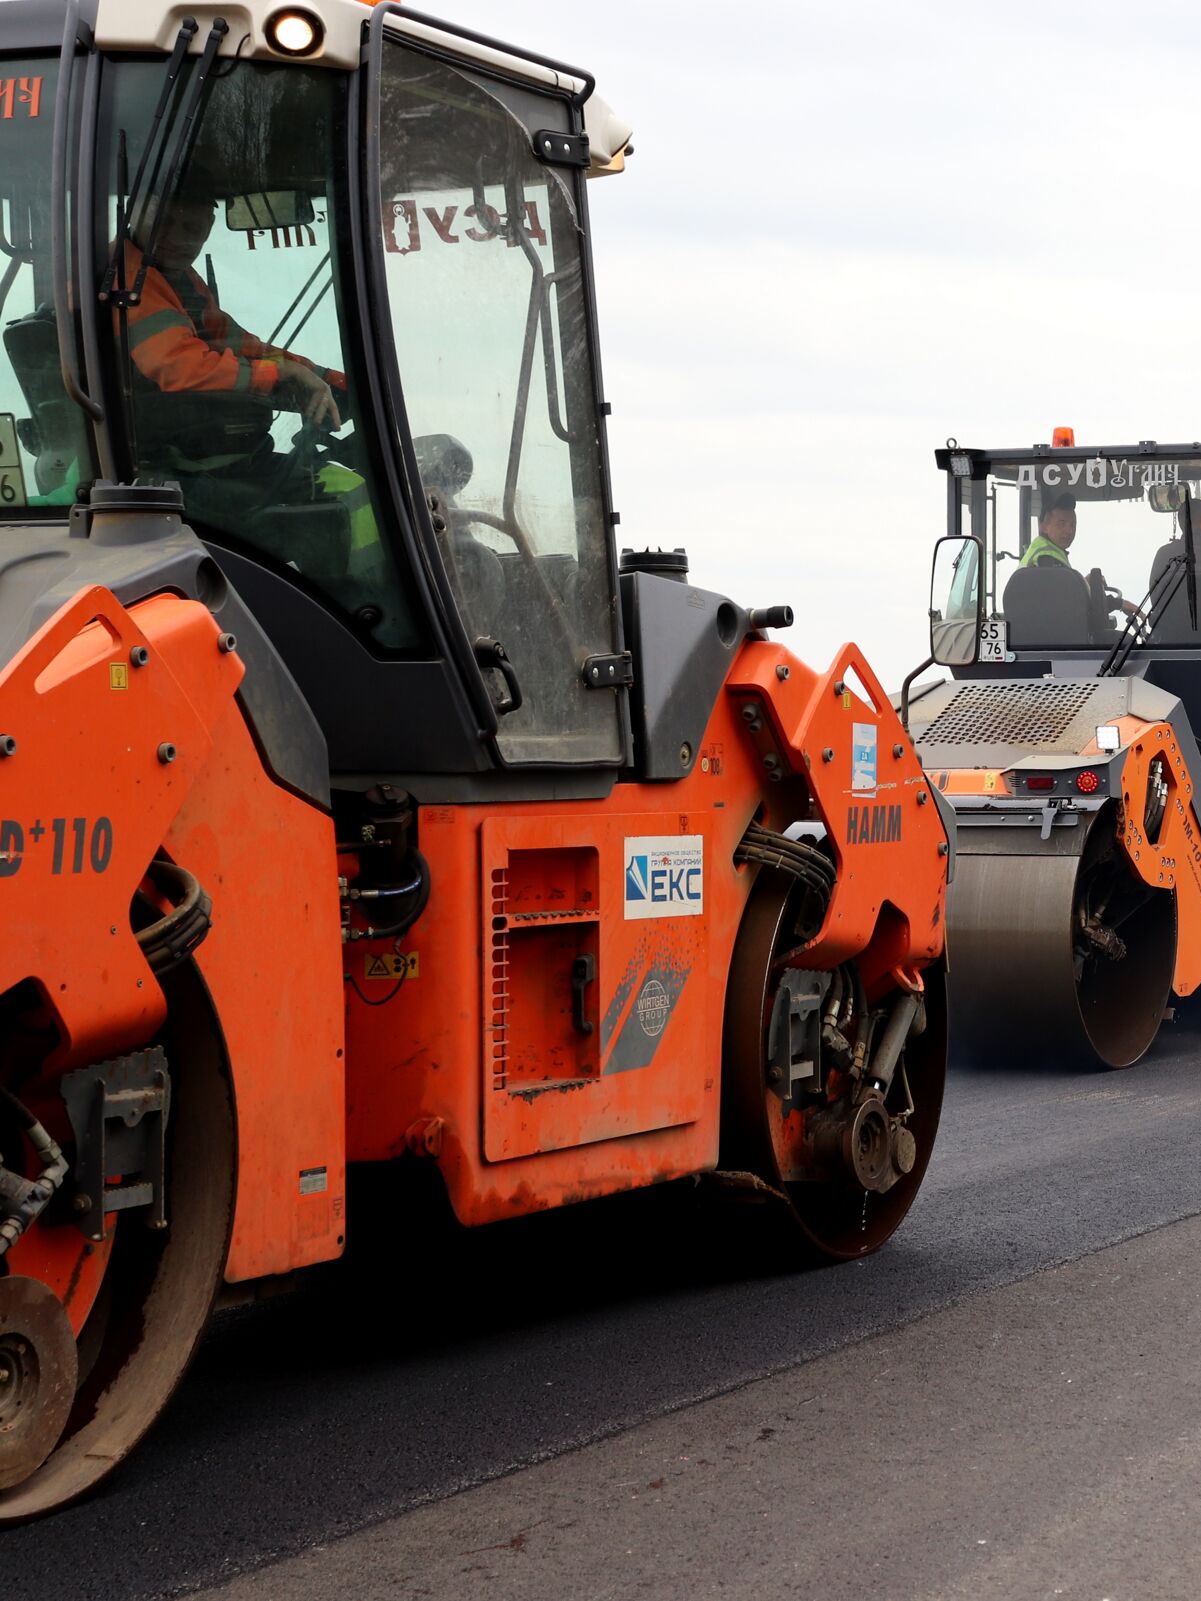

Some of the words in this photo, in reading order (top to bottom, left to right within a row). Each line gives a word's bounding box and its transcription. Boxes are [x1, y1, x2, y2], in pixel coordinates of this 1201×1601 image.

[1016, 464, 1085, 490] ДСУ
[986, 642, 1001, 655] 76
[847, 804, 902, 845] HAMM
[637, 995, 670, 1009] WIRTGEN
[640, 1008, 667, 1021] GROUP
